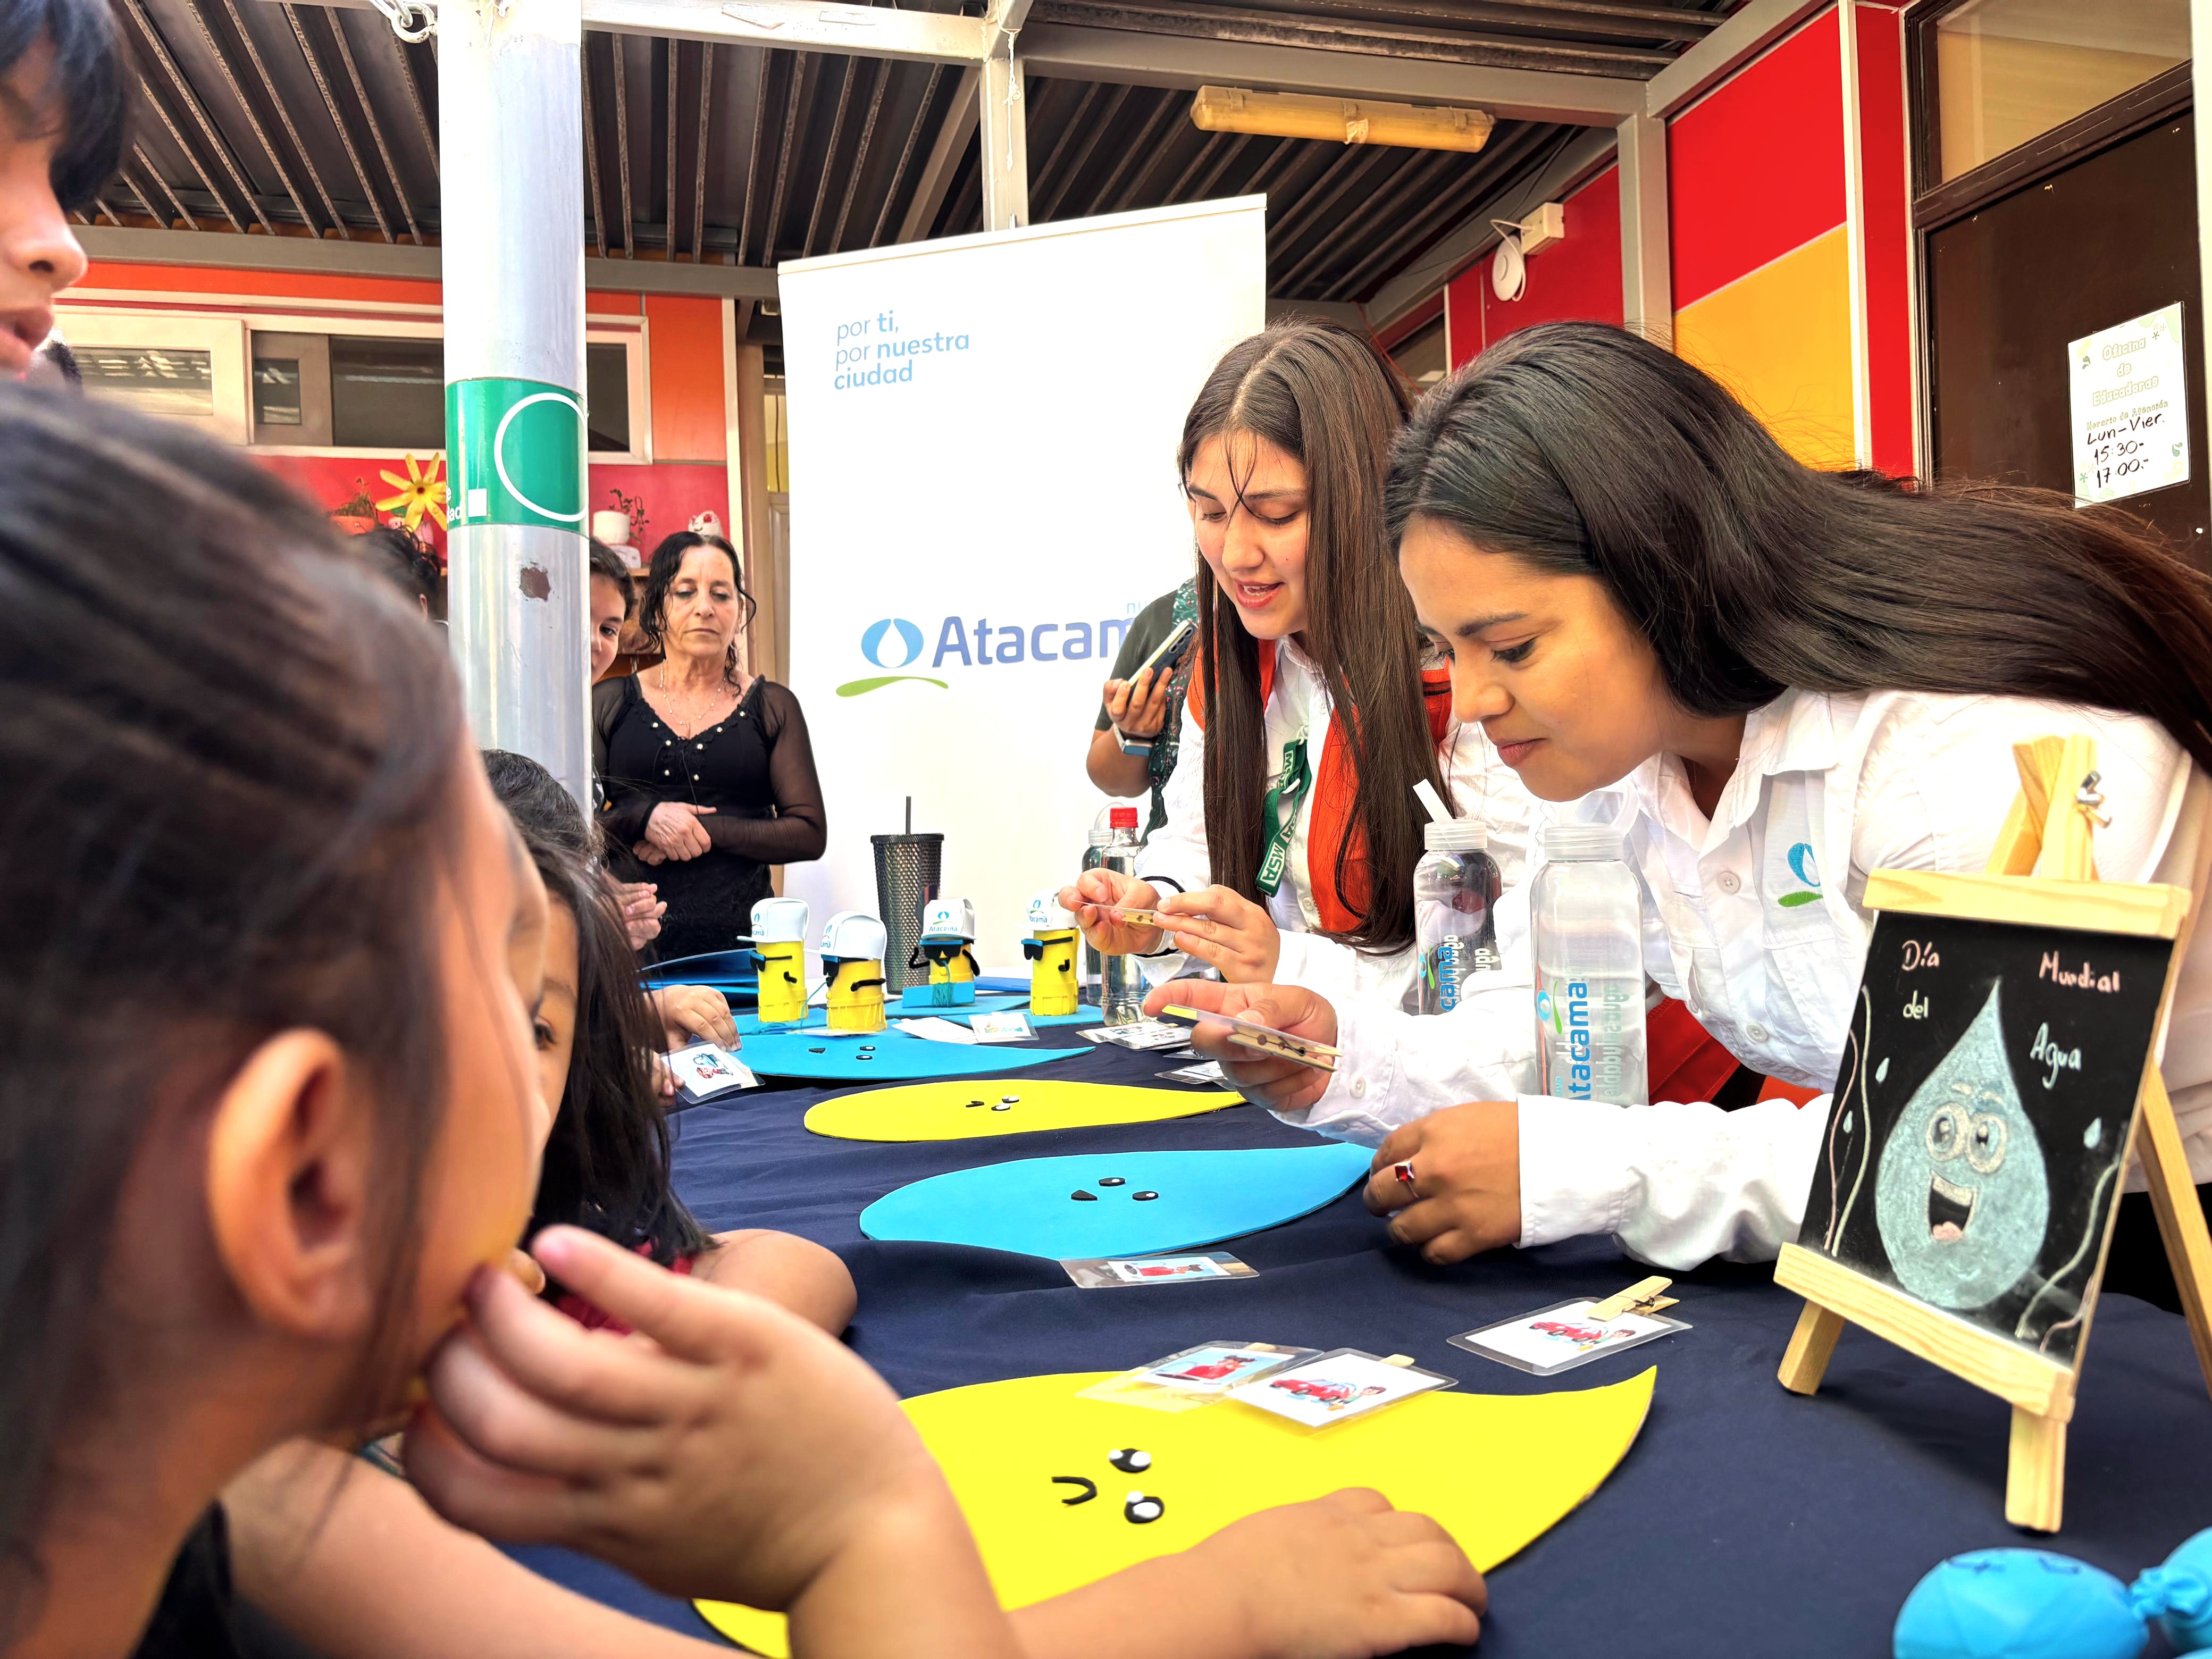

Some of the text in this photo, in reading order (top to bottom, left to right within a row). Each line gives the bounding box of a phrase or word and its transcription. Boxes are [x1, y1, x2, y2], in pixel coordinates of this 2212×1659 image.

[837, 310, 899, 346] por ti,
[836, 332, 969, 372] por nuestra
[2102, 337, 2146, 361] Oficina
[834, 359, 912, 390] ciudad
[2117, 363, 2132, 377] de
[2092, 375, 2159, 406] Educadoras
[932, 616, 1135, 668] Atacam
[1262, 844, 1284, 882] MSA
[1437, 946, 1457, 1011] cama
[2039, 950, 2121, 993] Mundial
[1903, 990, 2083, 1091] del Agua
